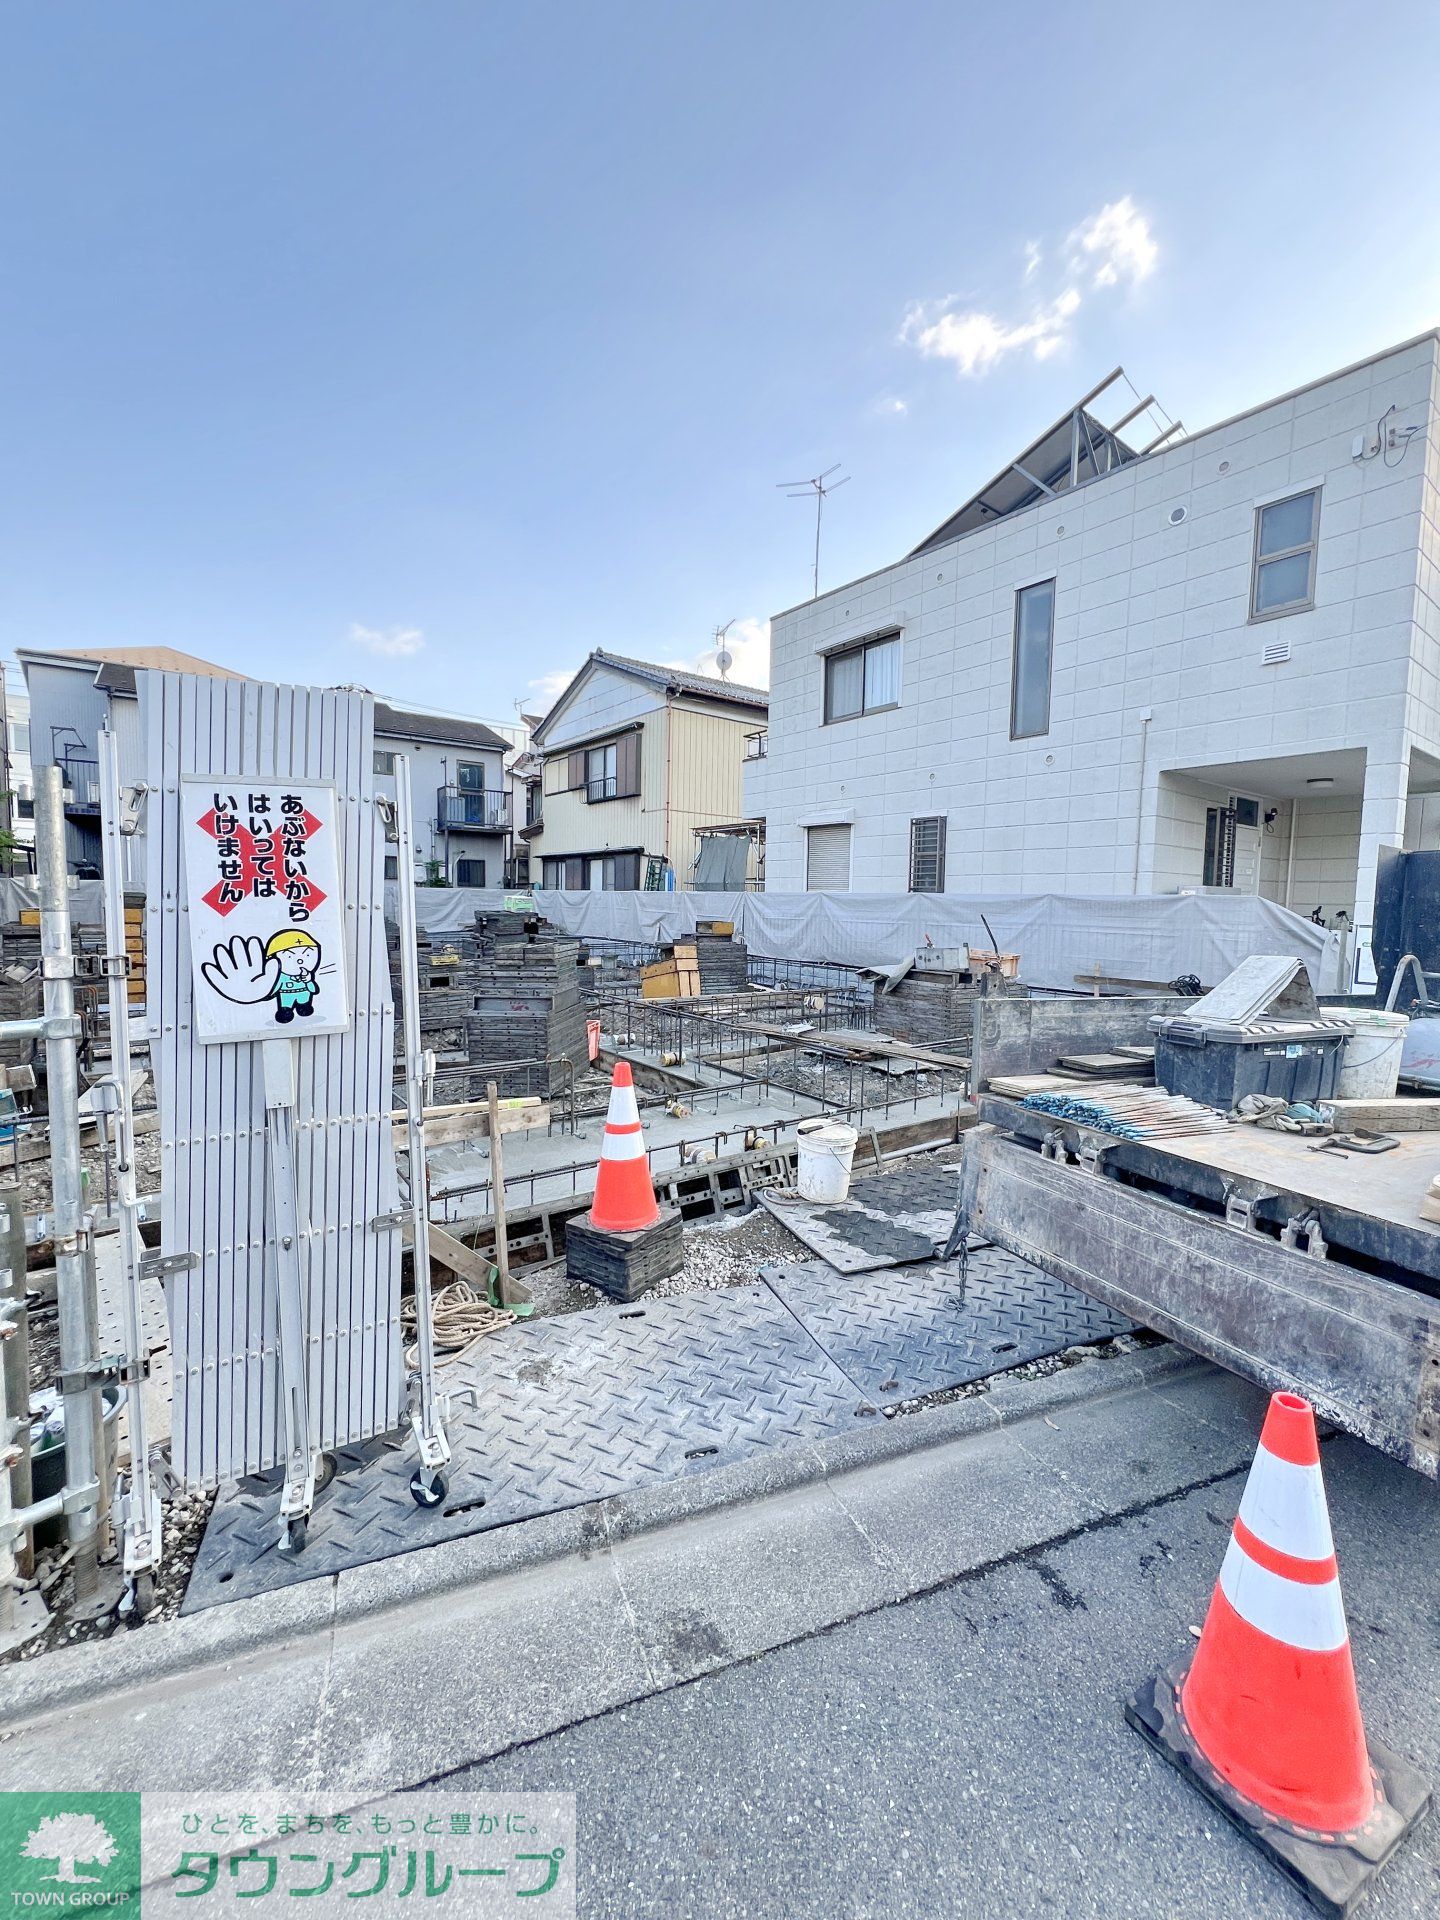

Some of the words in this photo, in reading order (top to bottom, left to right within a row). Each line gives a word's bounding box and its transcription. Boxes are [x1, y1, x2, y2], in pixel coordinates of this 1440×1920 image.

[213, 793, 244, 904] いけません
[247, 793, 277, 898] はいっては
[280, 794, 310, 923] あぶないから
